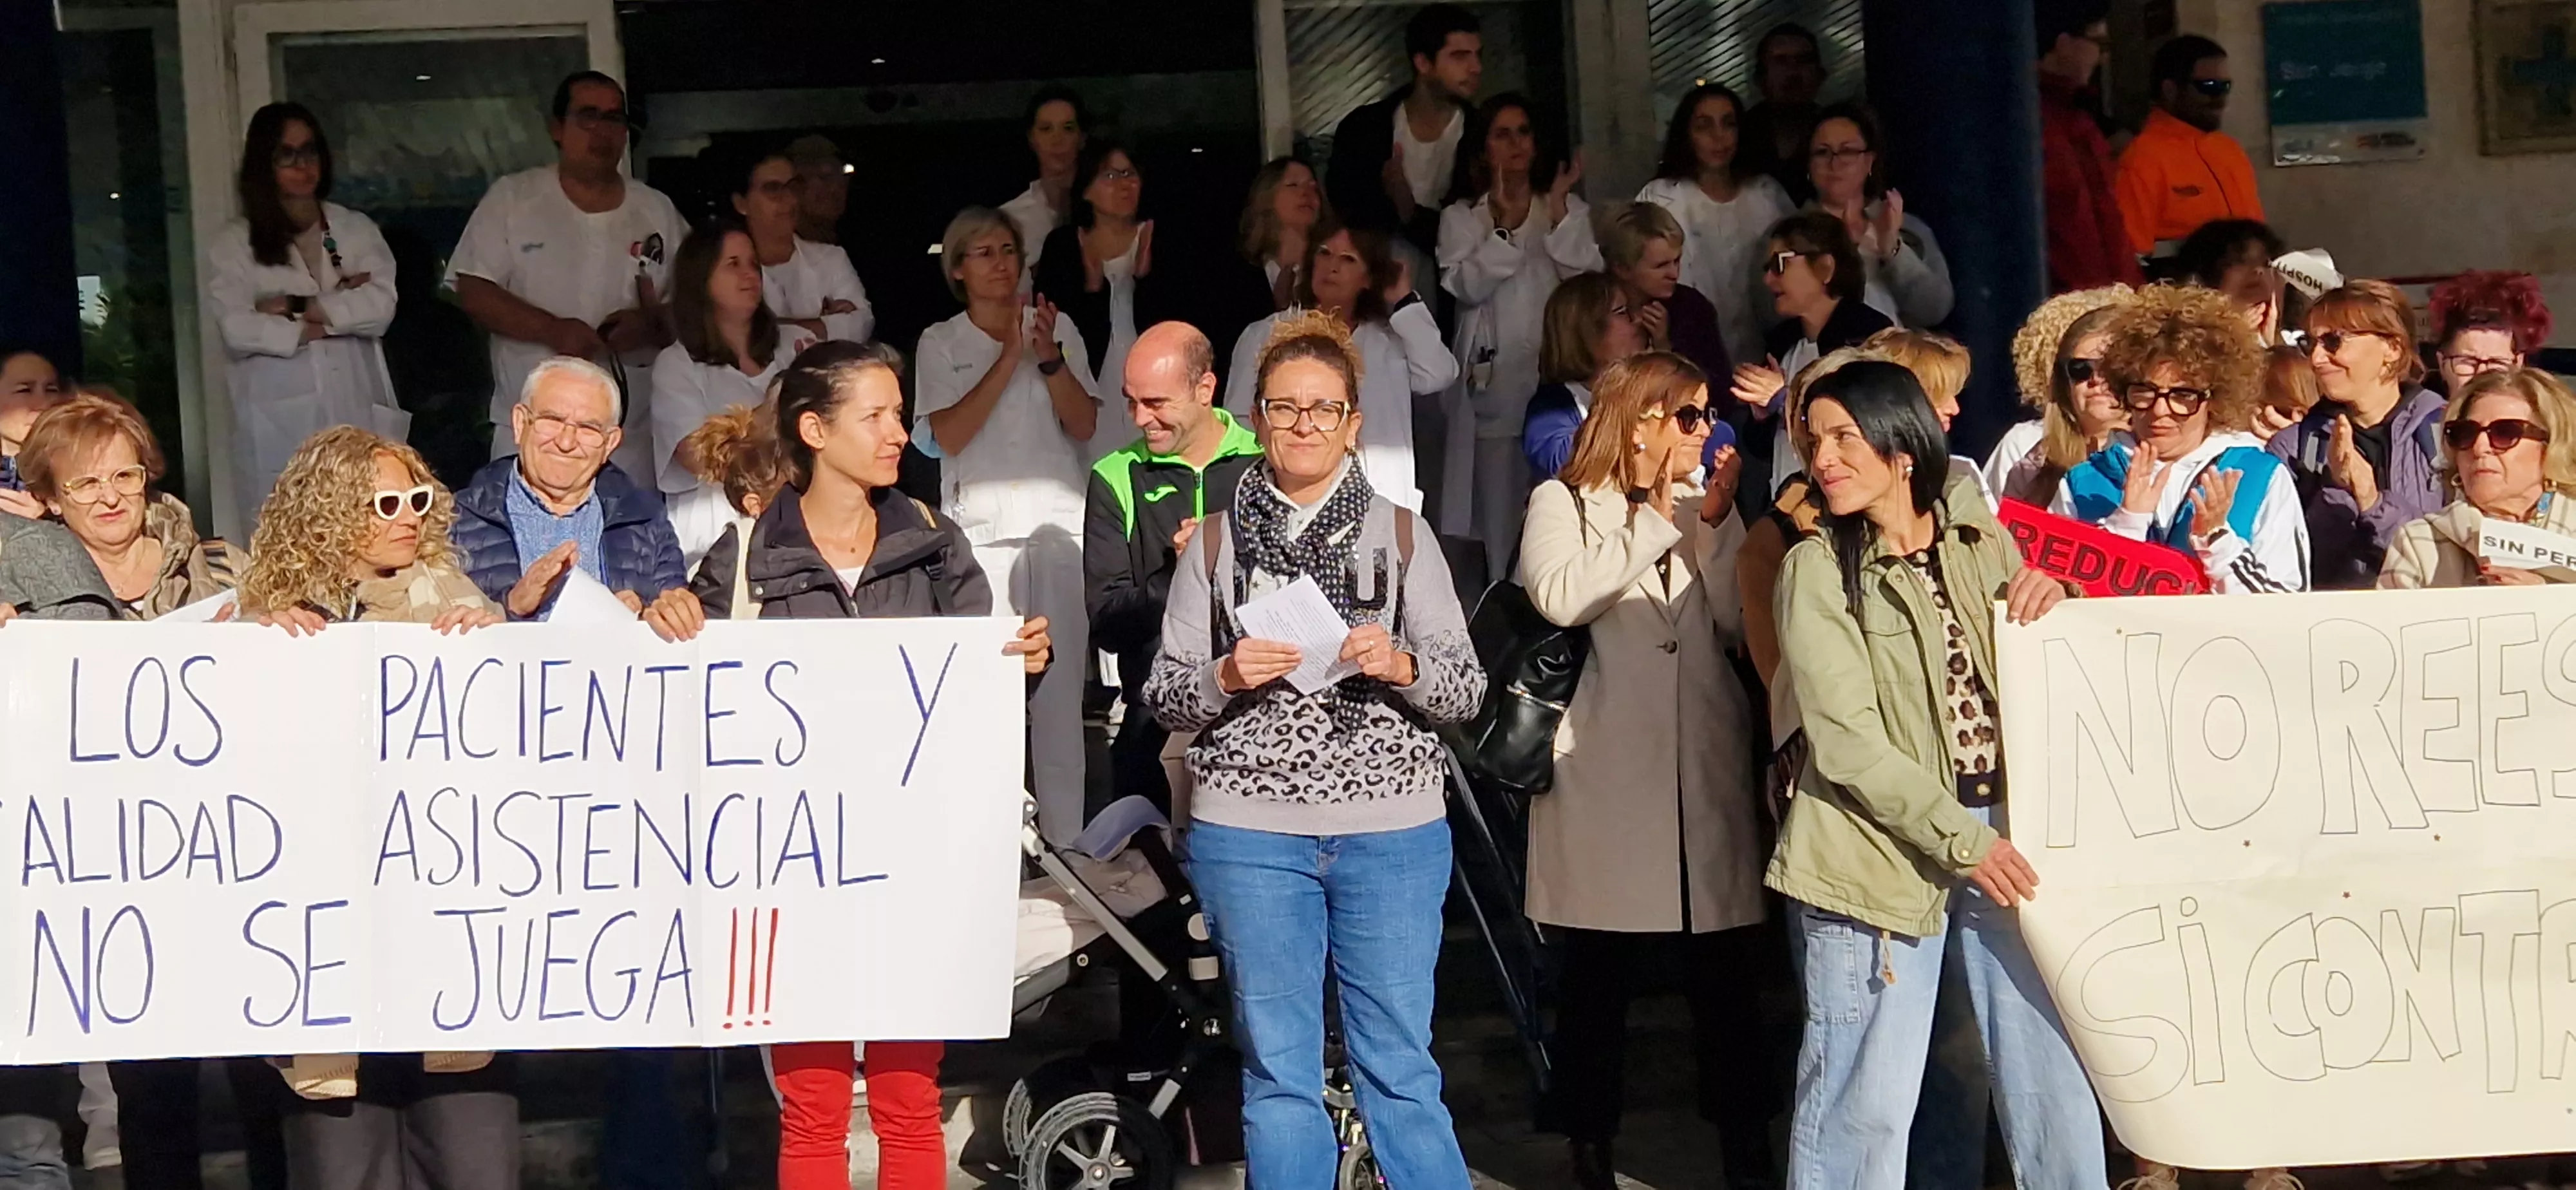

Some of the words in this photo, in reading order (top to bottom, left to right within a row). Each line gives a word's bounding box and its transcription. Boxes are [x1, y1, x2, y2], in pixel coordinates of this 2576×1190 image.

[2483, 536, 2524, 554] SIN
[71, 656, 223, 766] LOS
[381, 655, 807, 771] PACIENTES
[899, 643, 958, 786] Y
[2042, 632, 2281, 848] NO
[0, 795, 282, 887] ALIDAD
[374, 788, 889, 897] ASISTENCIAL
[28, 905, 154, 1037] NO
[243, 900, 352, 1028] SE
